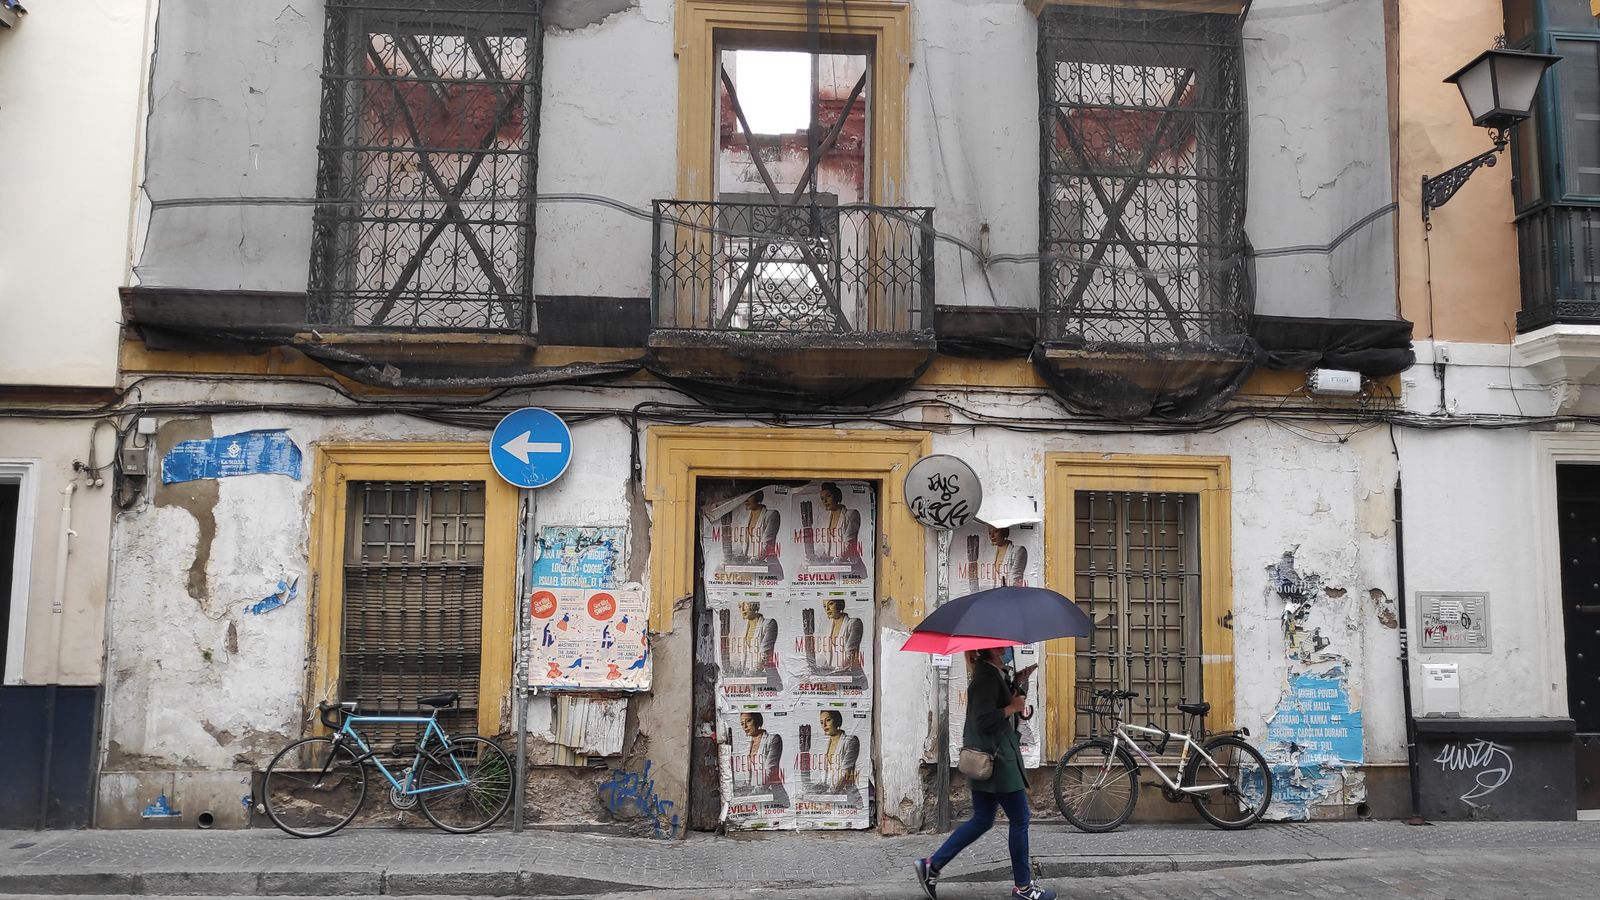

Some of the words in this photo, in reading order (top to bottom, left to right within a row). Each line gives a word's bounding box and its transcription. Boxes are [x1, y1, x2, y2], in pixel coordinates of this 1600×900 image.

[797, 574, 836, 582] SEVILLA
[799, 683, 837, 692] SEVILLA
[1324, 728, 1348, 738] DURANTE
[1029, 891, 1041, 900] N
